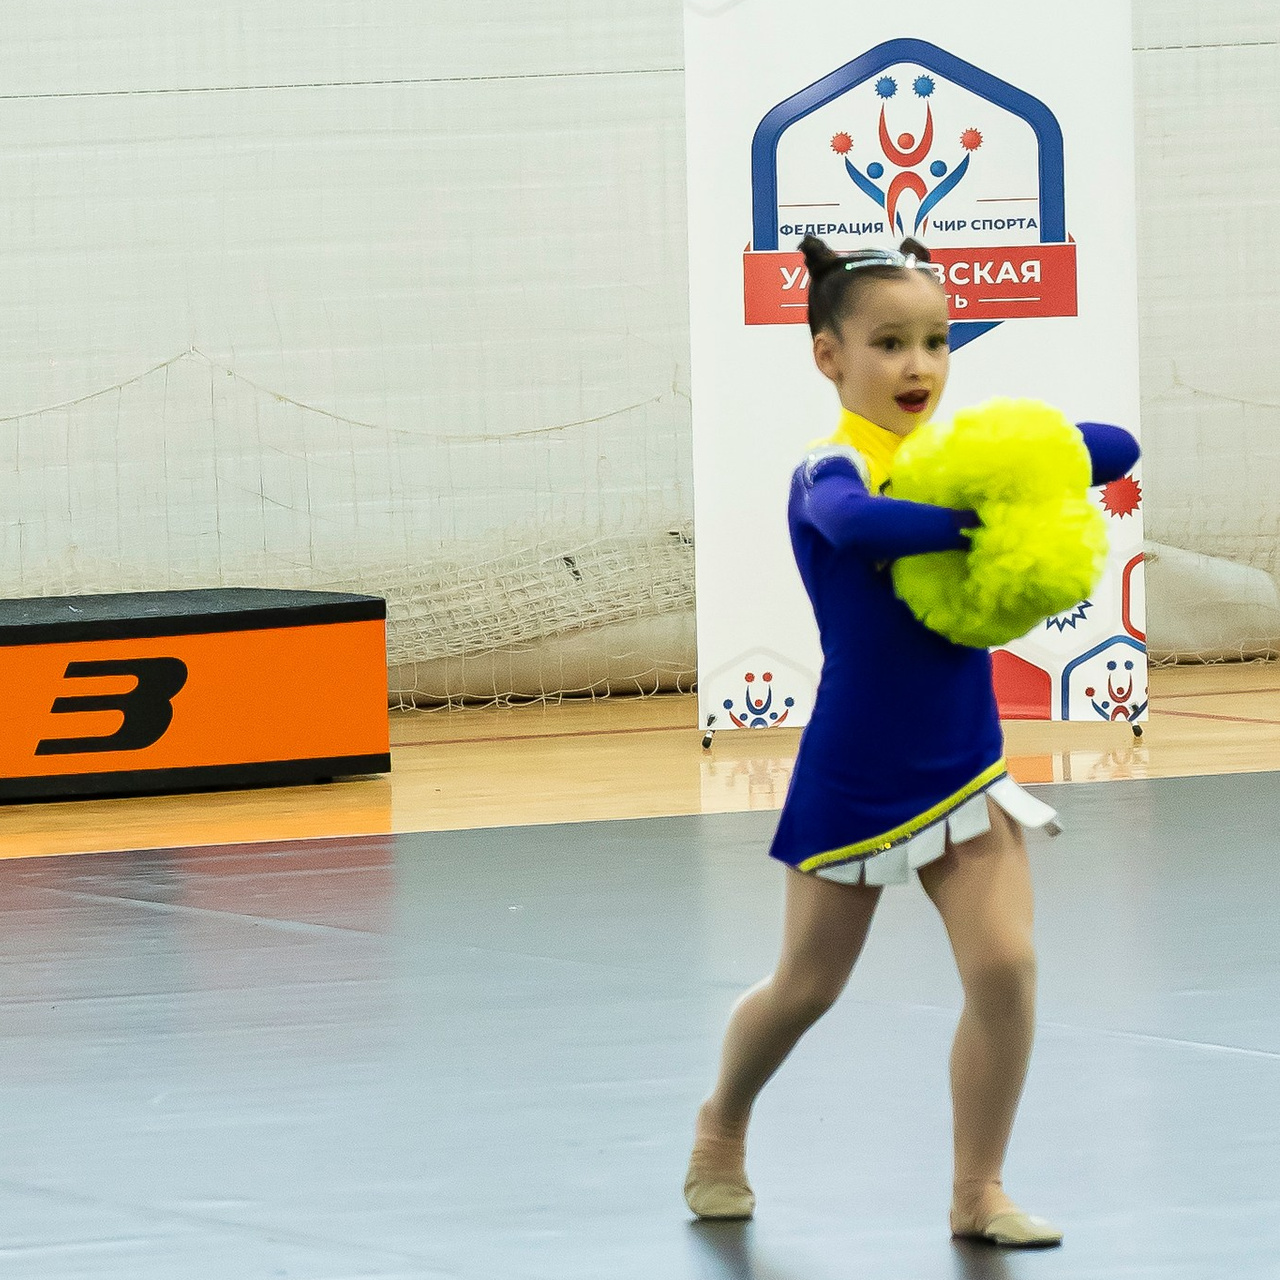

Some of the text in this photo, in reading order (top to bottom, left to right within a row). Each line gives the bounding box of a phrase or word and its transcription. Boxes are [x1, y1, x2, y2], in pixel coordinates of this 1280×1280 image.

[779, 218, 1038, 236] ФЕДЕРАЦИЯ ЧИР СПОРТА
[779, 260, 1041, 290] УВСКАЯ
[34, 657, 188, 755] 3
